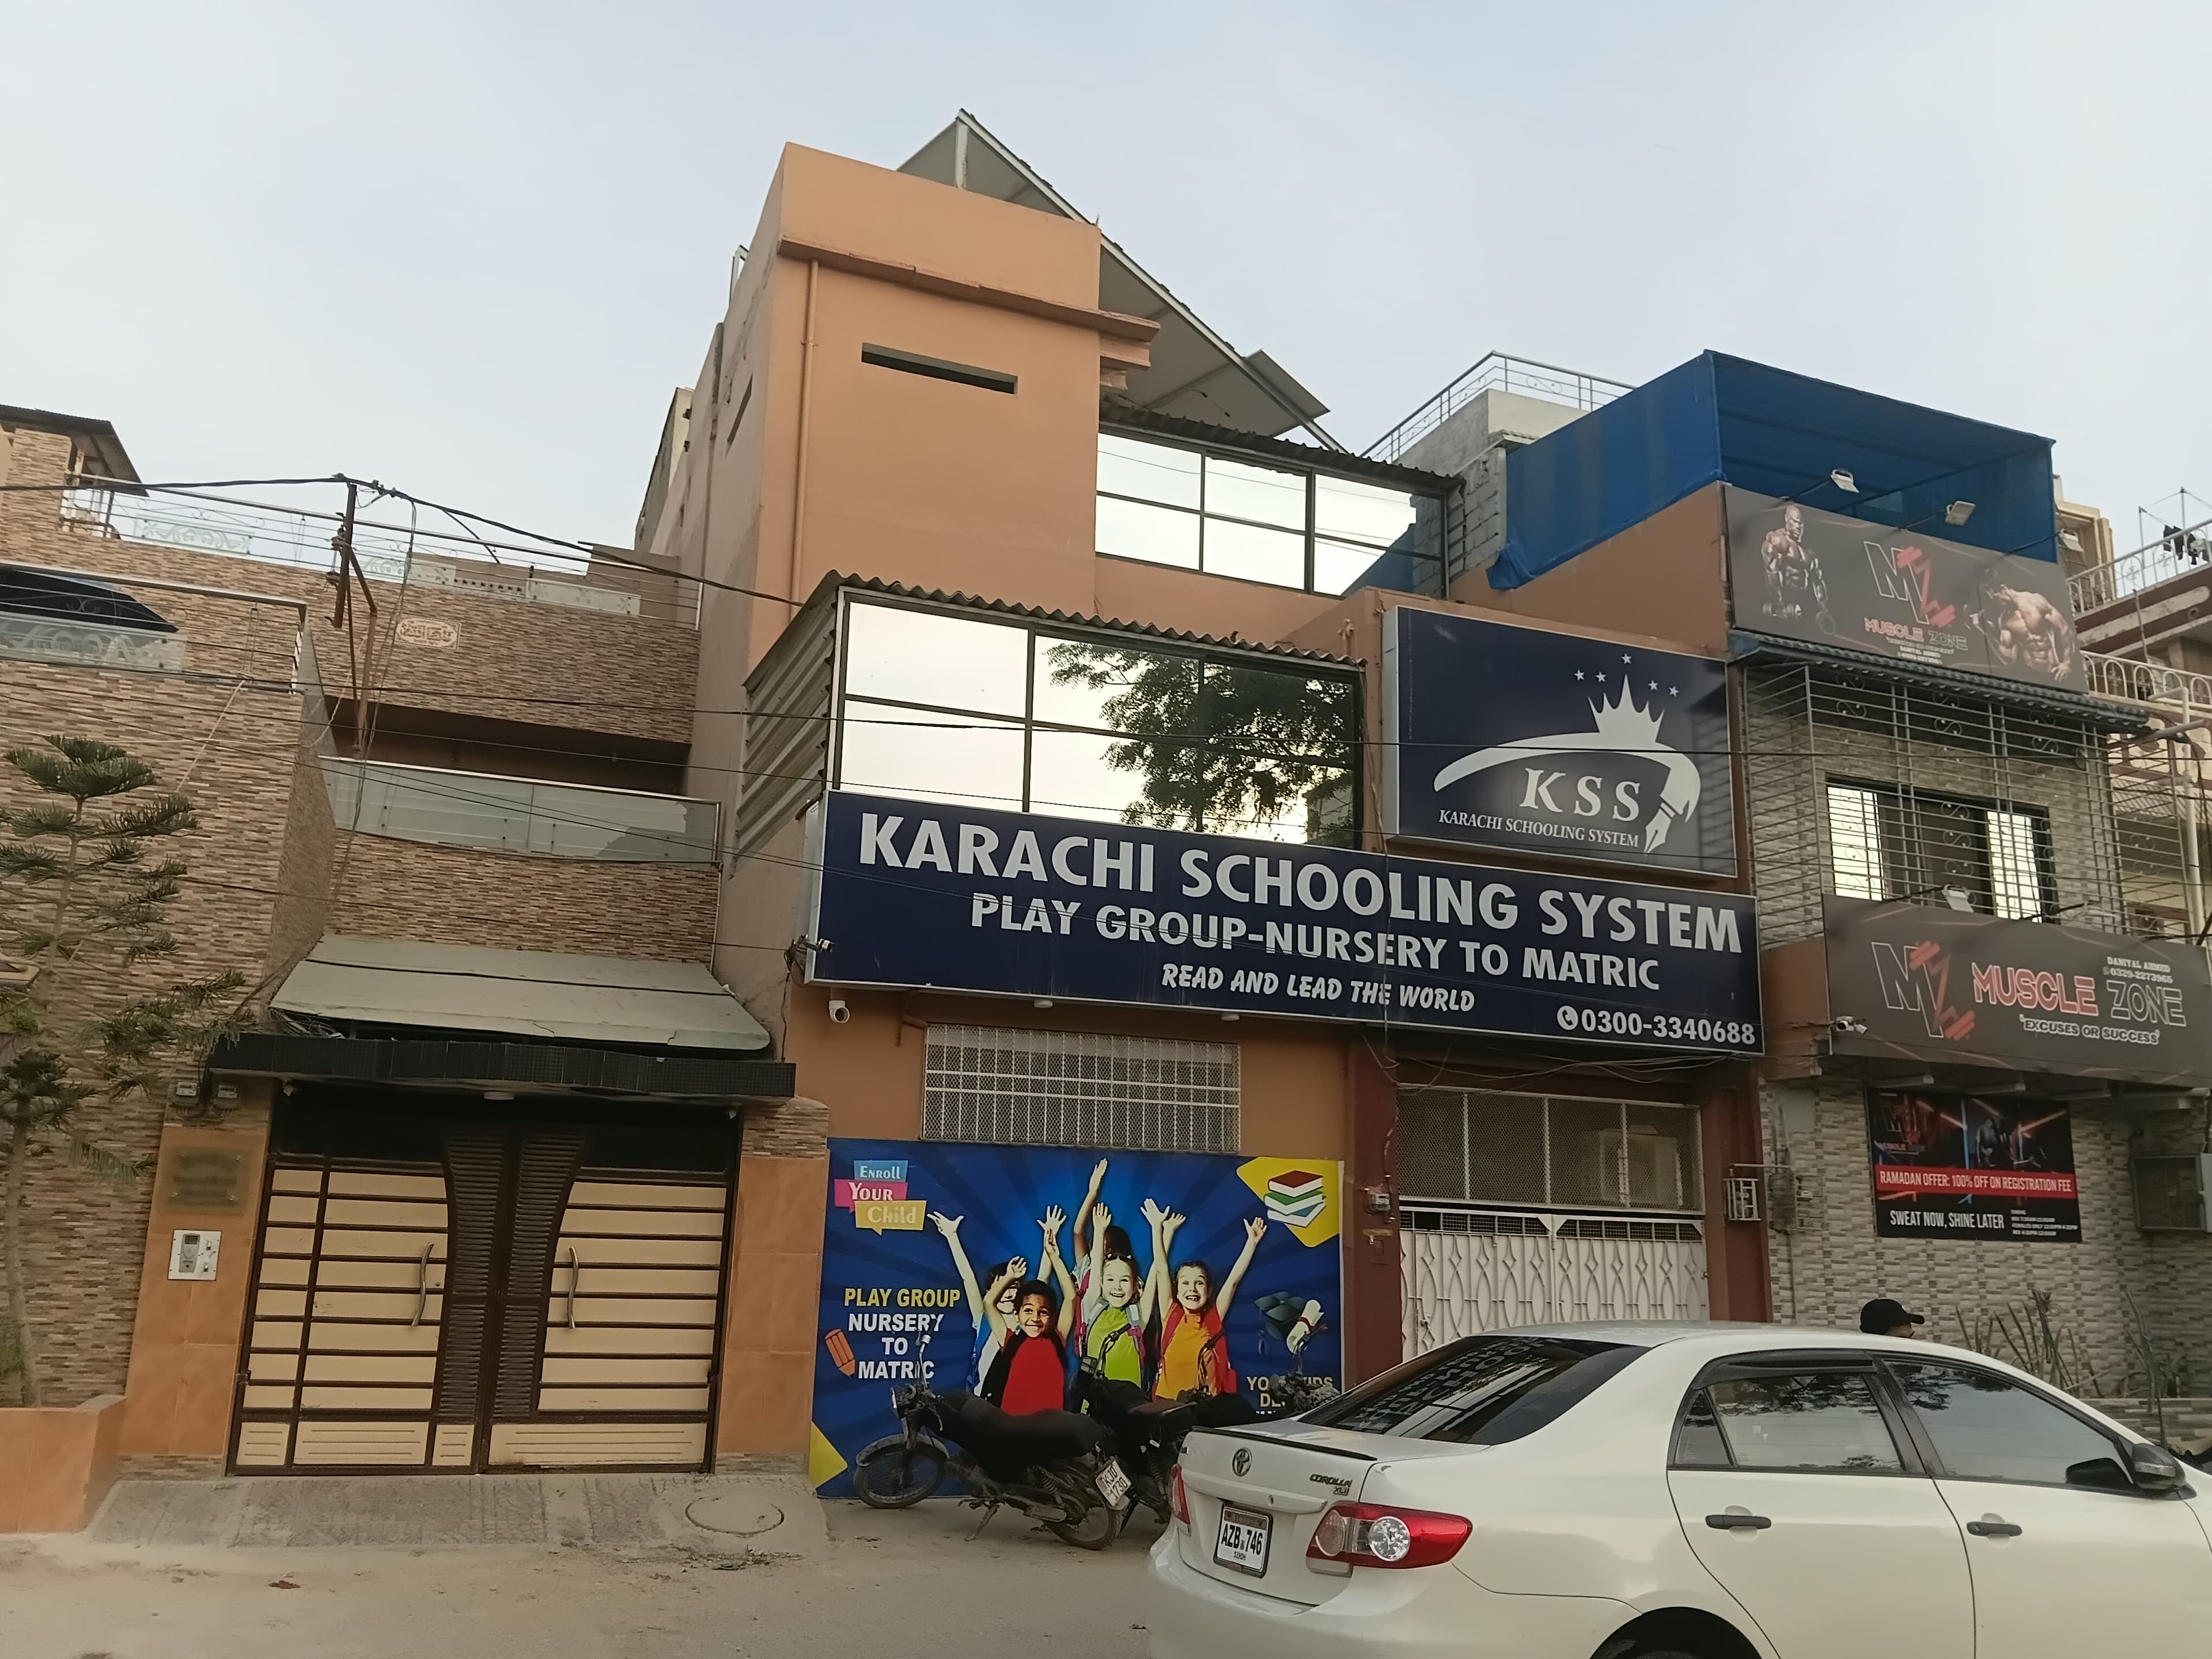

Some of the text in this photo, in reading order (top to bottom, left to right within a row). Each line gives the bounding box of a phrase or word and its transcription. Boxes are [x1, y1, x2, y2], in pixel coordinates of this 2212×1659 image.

[1864, 618, 1924, 642] MUSCLE
[1928, 630, 1968, 651] ZONE
[1439, 809, 1638, 847] KARACHI SCHOOLING SYSTEM
[859, 812, 1742, 953] KARACHI SCHOOLING SYSTEM
[971, 892, 1660, 991] PLAY GROUP-NURSERY TO MATRIC
[2107, 956, 2142, 968] DANIYAL
[1162, 963, 1475, 1013] READ AND LEAD THE WORLD
[1971, 962, 2187, 1027] MUSCLE ZONE
[1581, 1008, 1755, 1046] 0300-3340688
[2081, 1024, 2100, 1039] OR
[1880, 1171, 2072, 1192] RAMADAN OFFER: 100% OFF ON REGISTRATION FEE
[867, 1206, 916, 1224] Child
[1890, 1210, 1922, 1226] SWEAT
[1923, 1211, 1948, 1229] NOW,
[1948, 1212, 1976, 1228] SHINE
[1976, 1213, 2005, 1229] LATER
[844, 1288, 961, 1308] PLAY GROUP
[849, 1313, 944, 1332] NURSERY
[881, 1338, 908, 1355] TO
[1111, 1477, 1128, 1498] 1730
[1221, 1523, 1263, 1555] AZB 746
